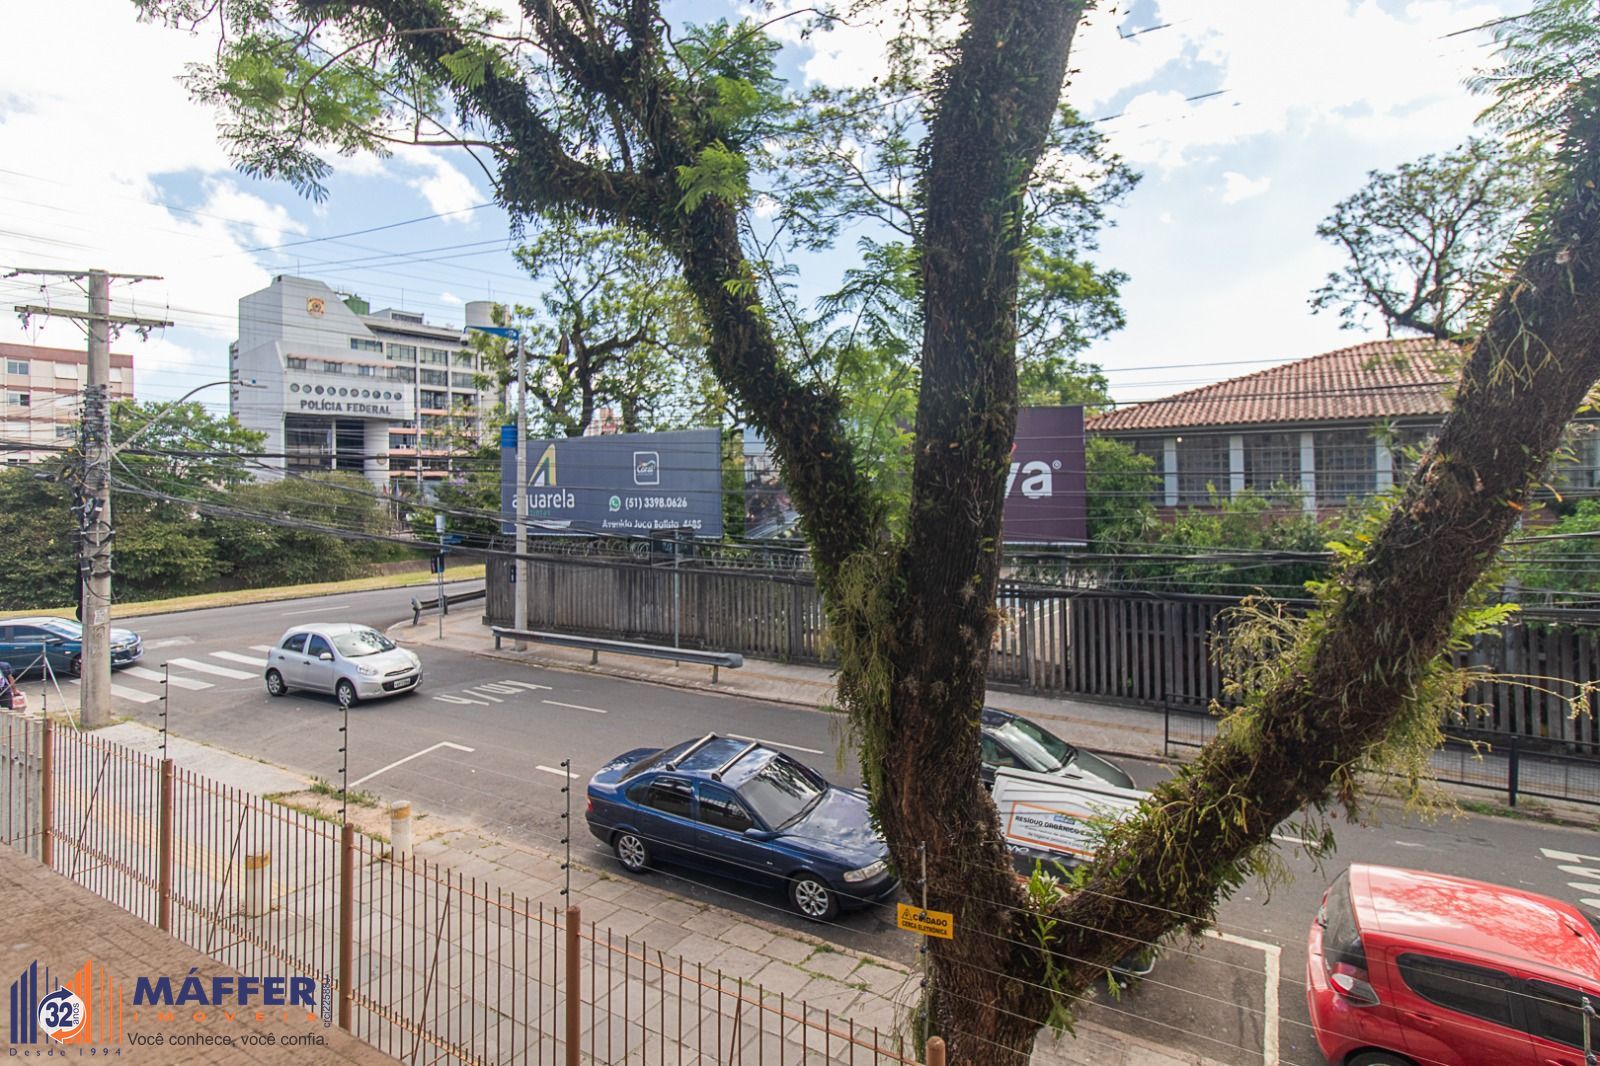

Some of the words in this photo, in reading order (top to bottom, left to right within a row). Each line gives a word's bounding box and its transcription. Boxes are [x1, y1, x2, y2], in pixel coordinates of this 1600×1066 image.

[300, 399, 342, 412] POLÍCIA
[346, 403, 391, 415] FEDERAL
[512, 488, 575, 516] auarela
[625, 497, 642, 510] (51)
[644, 497, 688, 508] 3398.0626
[602, 520, 632, 529] Avenida
[634, 520, 652, 529] Juca
[913, 913, 947, 927] CDADO
